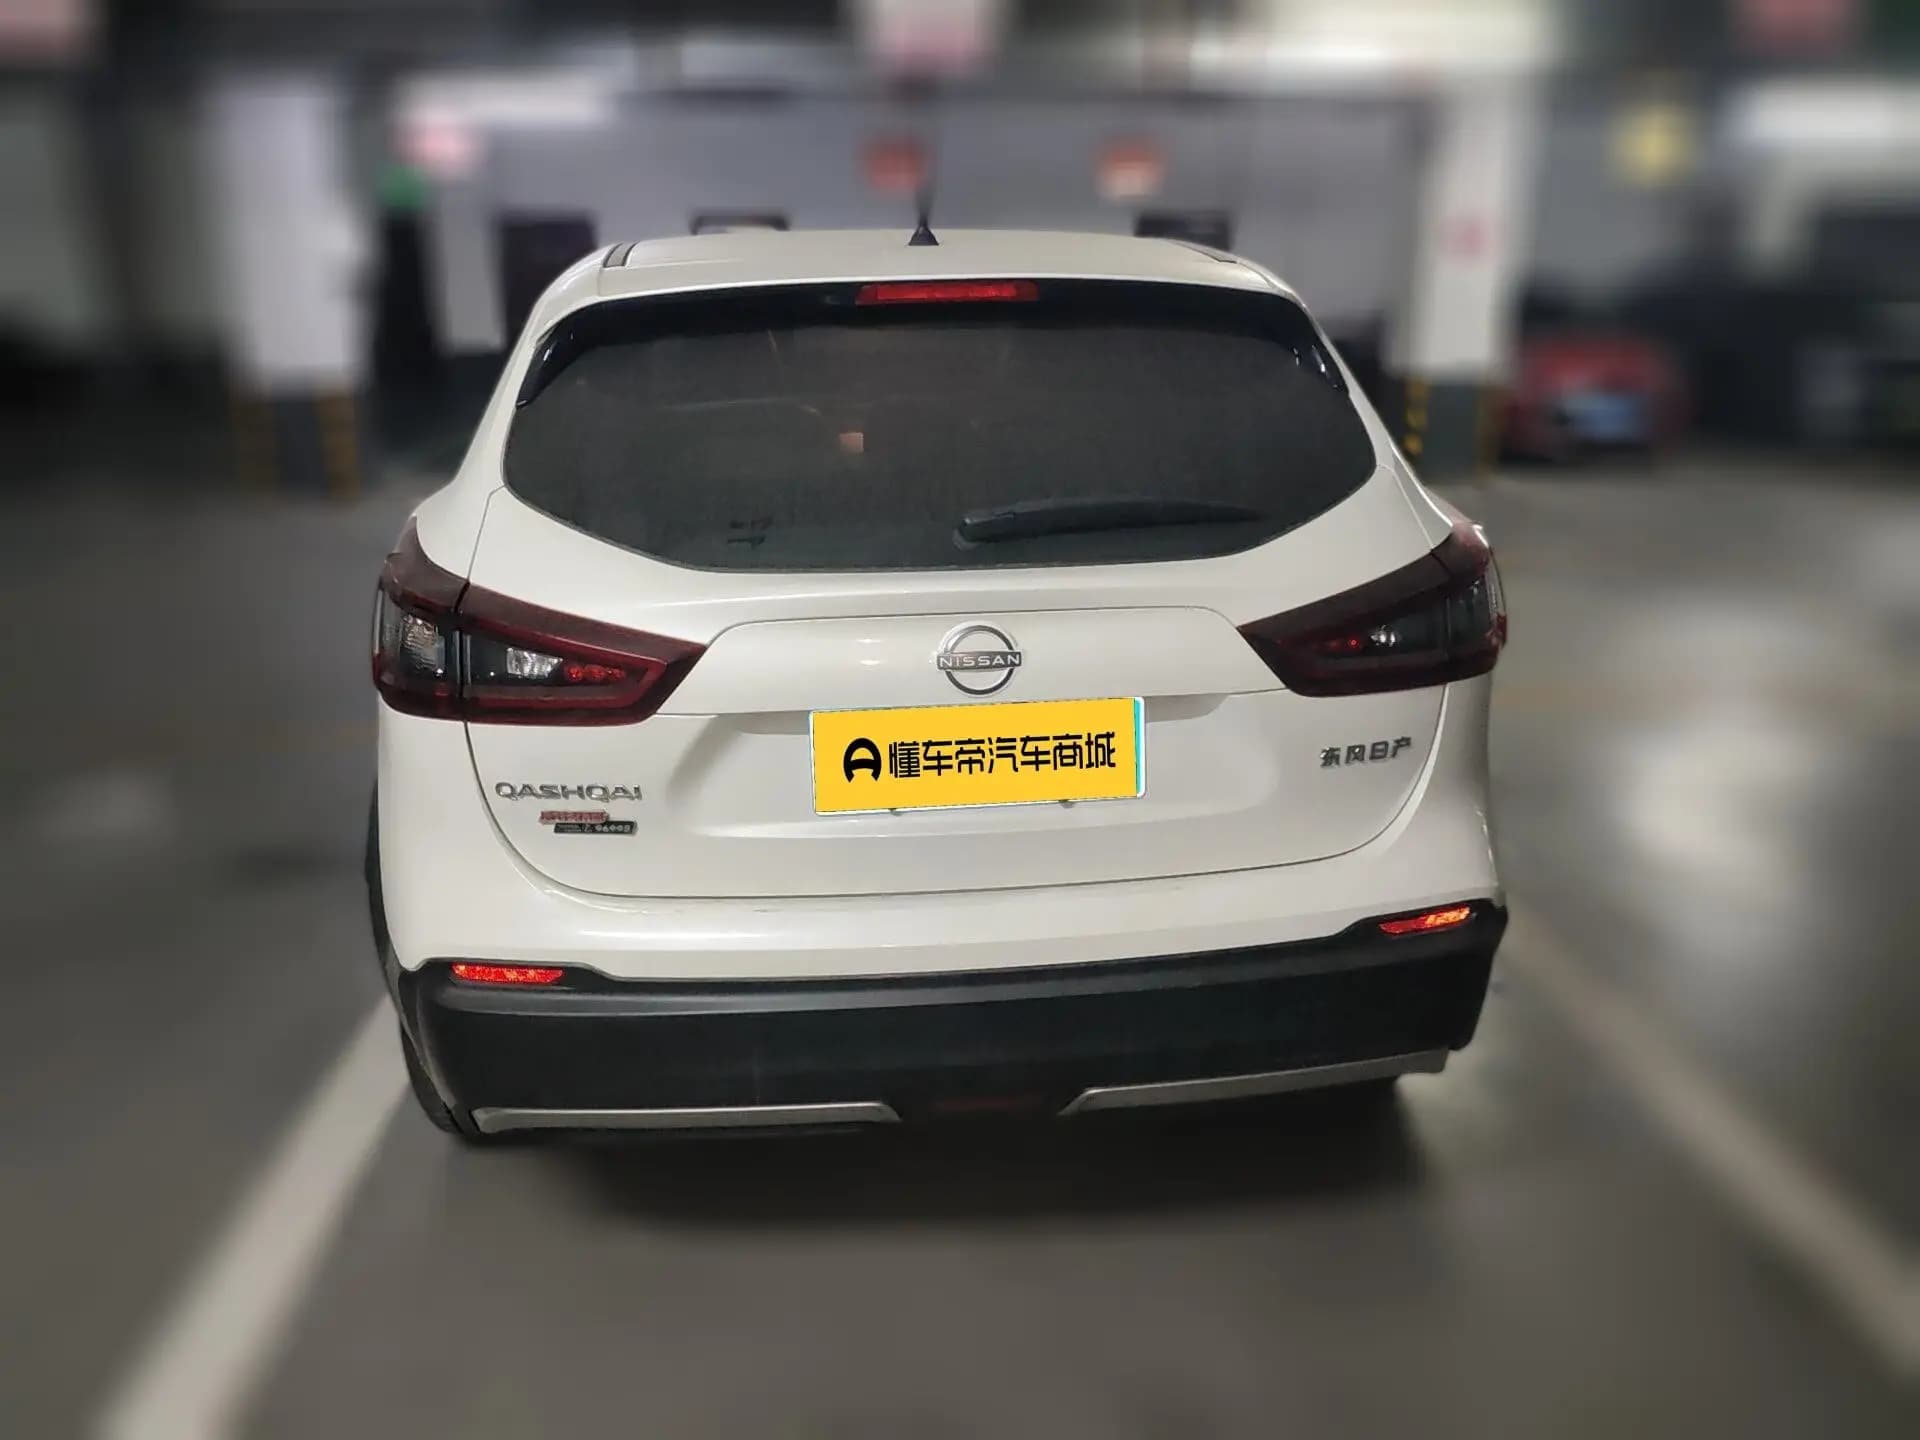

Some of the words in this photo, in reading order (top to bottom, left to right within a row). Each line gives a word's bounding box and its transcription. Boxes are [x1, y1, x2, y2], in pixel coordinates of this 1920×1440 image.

[940, 654, 1020, 668] NISSAN
[1319, 736, 1412, 768] 东风日产
[495, 782, 643, 802] QASHQAI
